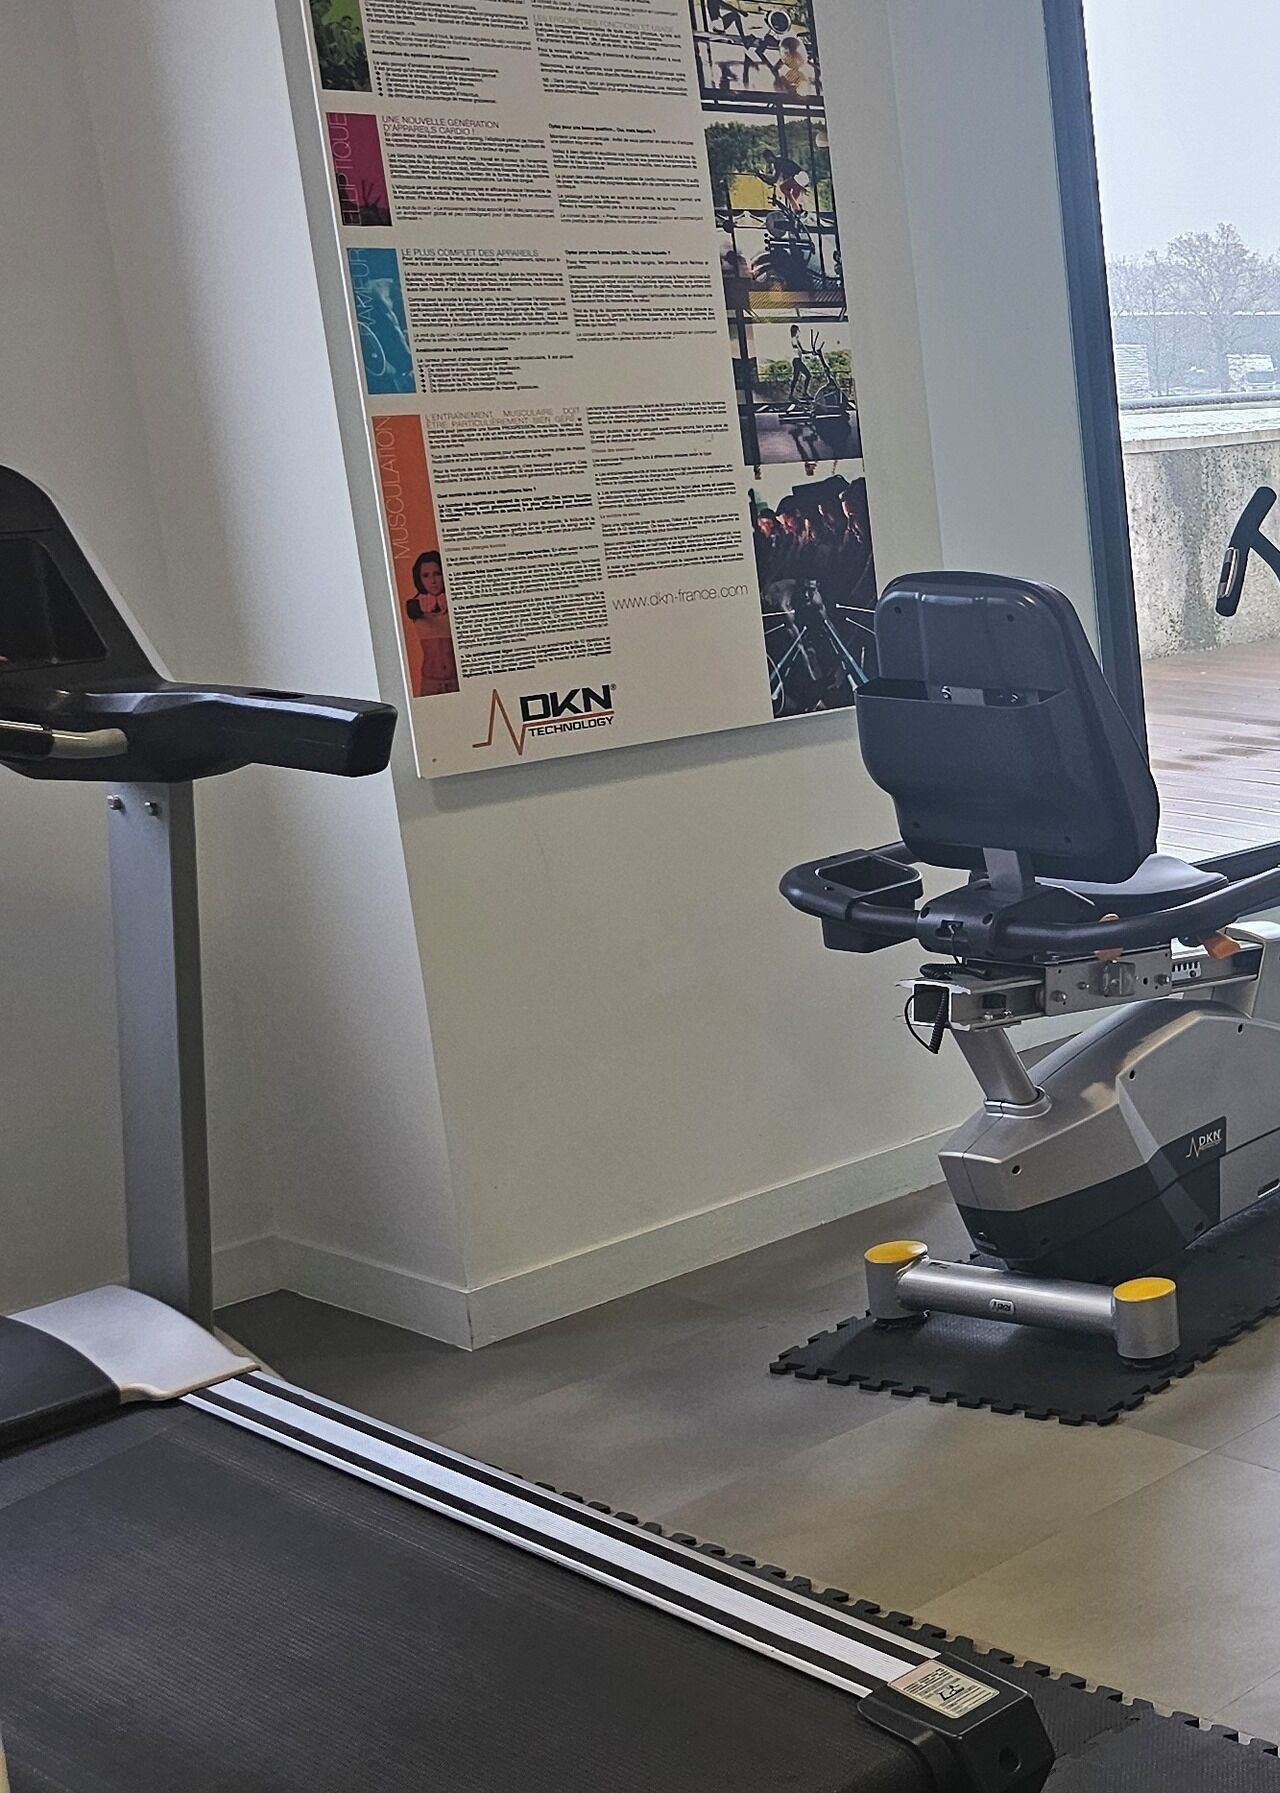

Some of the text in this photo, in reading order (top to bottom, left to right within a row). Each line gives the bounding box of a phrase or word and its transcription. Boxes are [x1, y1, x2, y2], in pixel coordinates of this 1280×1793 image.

[402, 116, 447, 126] NOUVELLE
[439, 127, 470, 135] CARDIO
[479, 249, 495, 257] DES
[375, 416, 411, 559] MUSCULATION
[612, 583, 749, 610] www.dkn-france.com
[528, 716, 614, 737] TECHNOLOGY
[1199, 1129, 1222, 1147] DKN
